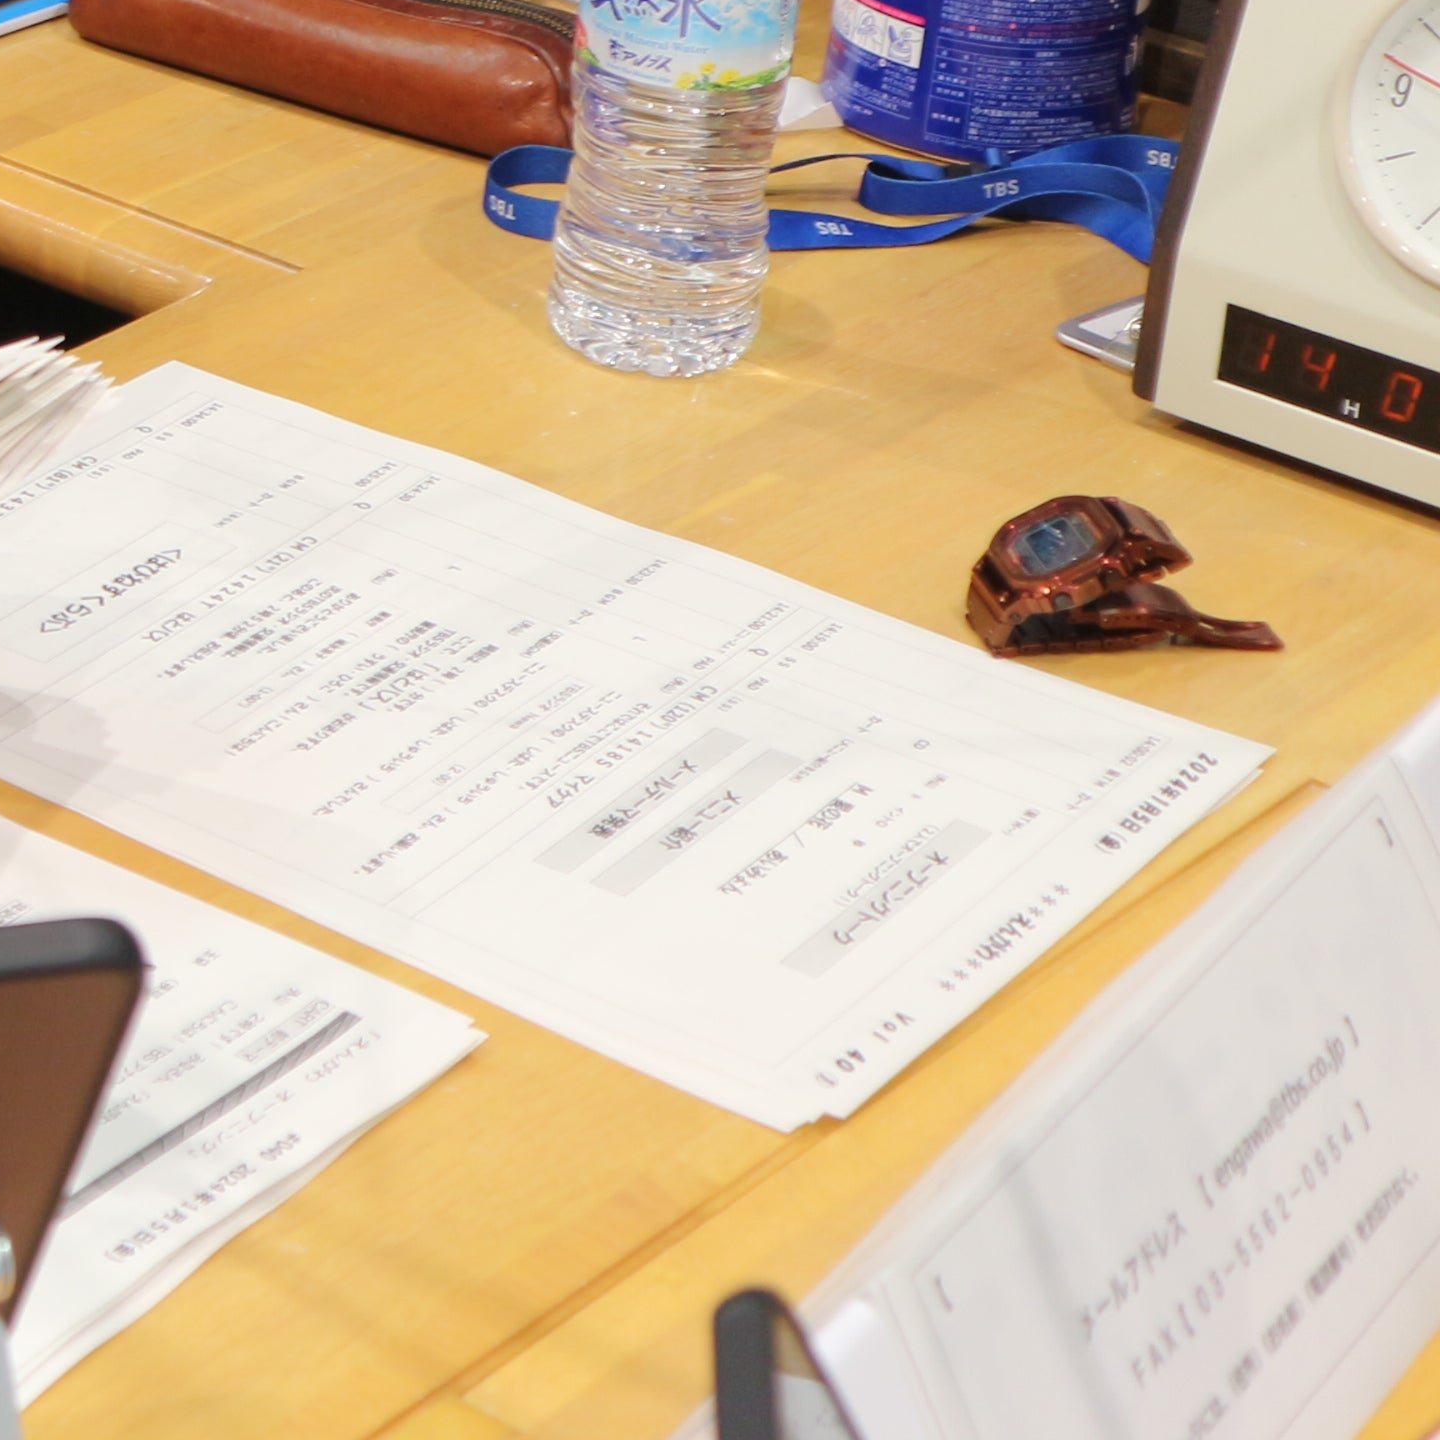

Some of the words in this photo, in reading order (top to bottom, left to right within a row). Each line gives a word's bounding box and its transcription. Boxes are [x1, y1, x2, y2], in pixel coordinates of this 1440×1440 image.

[1390, 72, 1413, 108] 9
[983, 179, 1020, 199] TBS
[489, 194, 517, 221] TBS
[814, 221, 854, 237] TBS
[141, 611, 196, 642] はとバス
[545, 774, 595, 809] マイケア
[587, 758, 697, 839] メールテーマ発表
[658, 789, 741, 850] メニュー紹介
[716, 846, 788, 895] あいみょん
[831, 849, 949, 945] オープニングトーク
